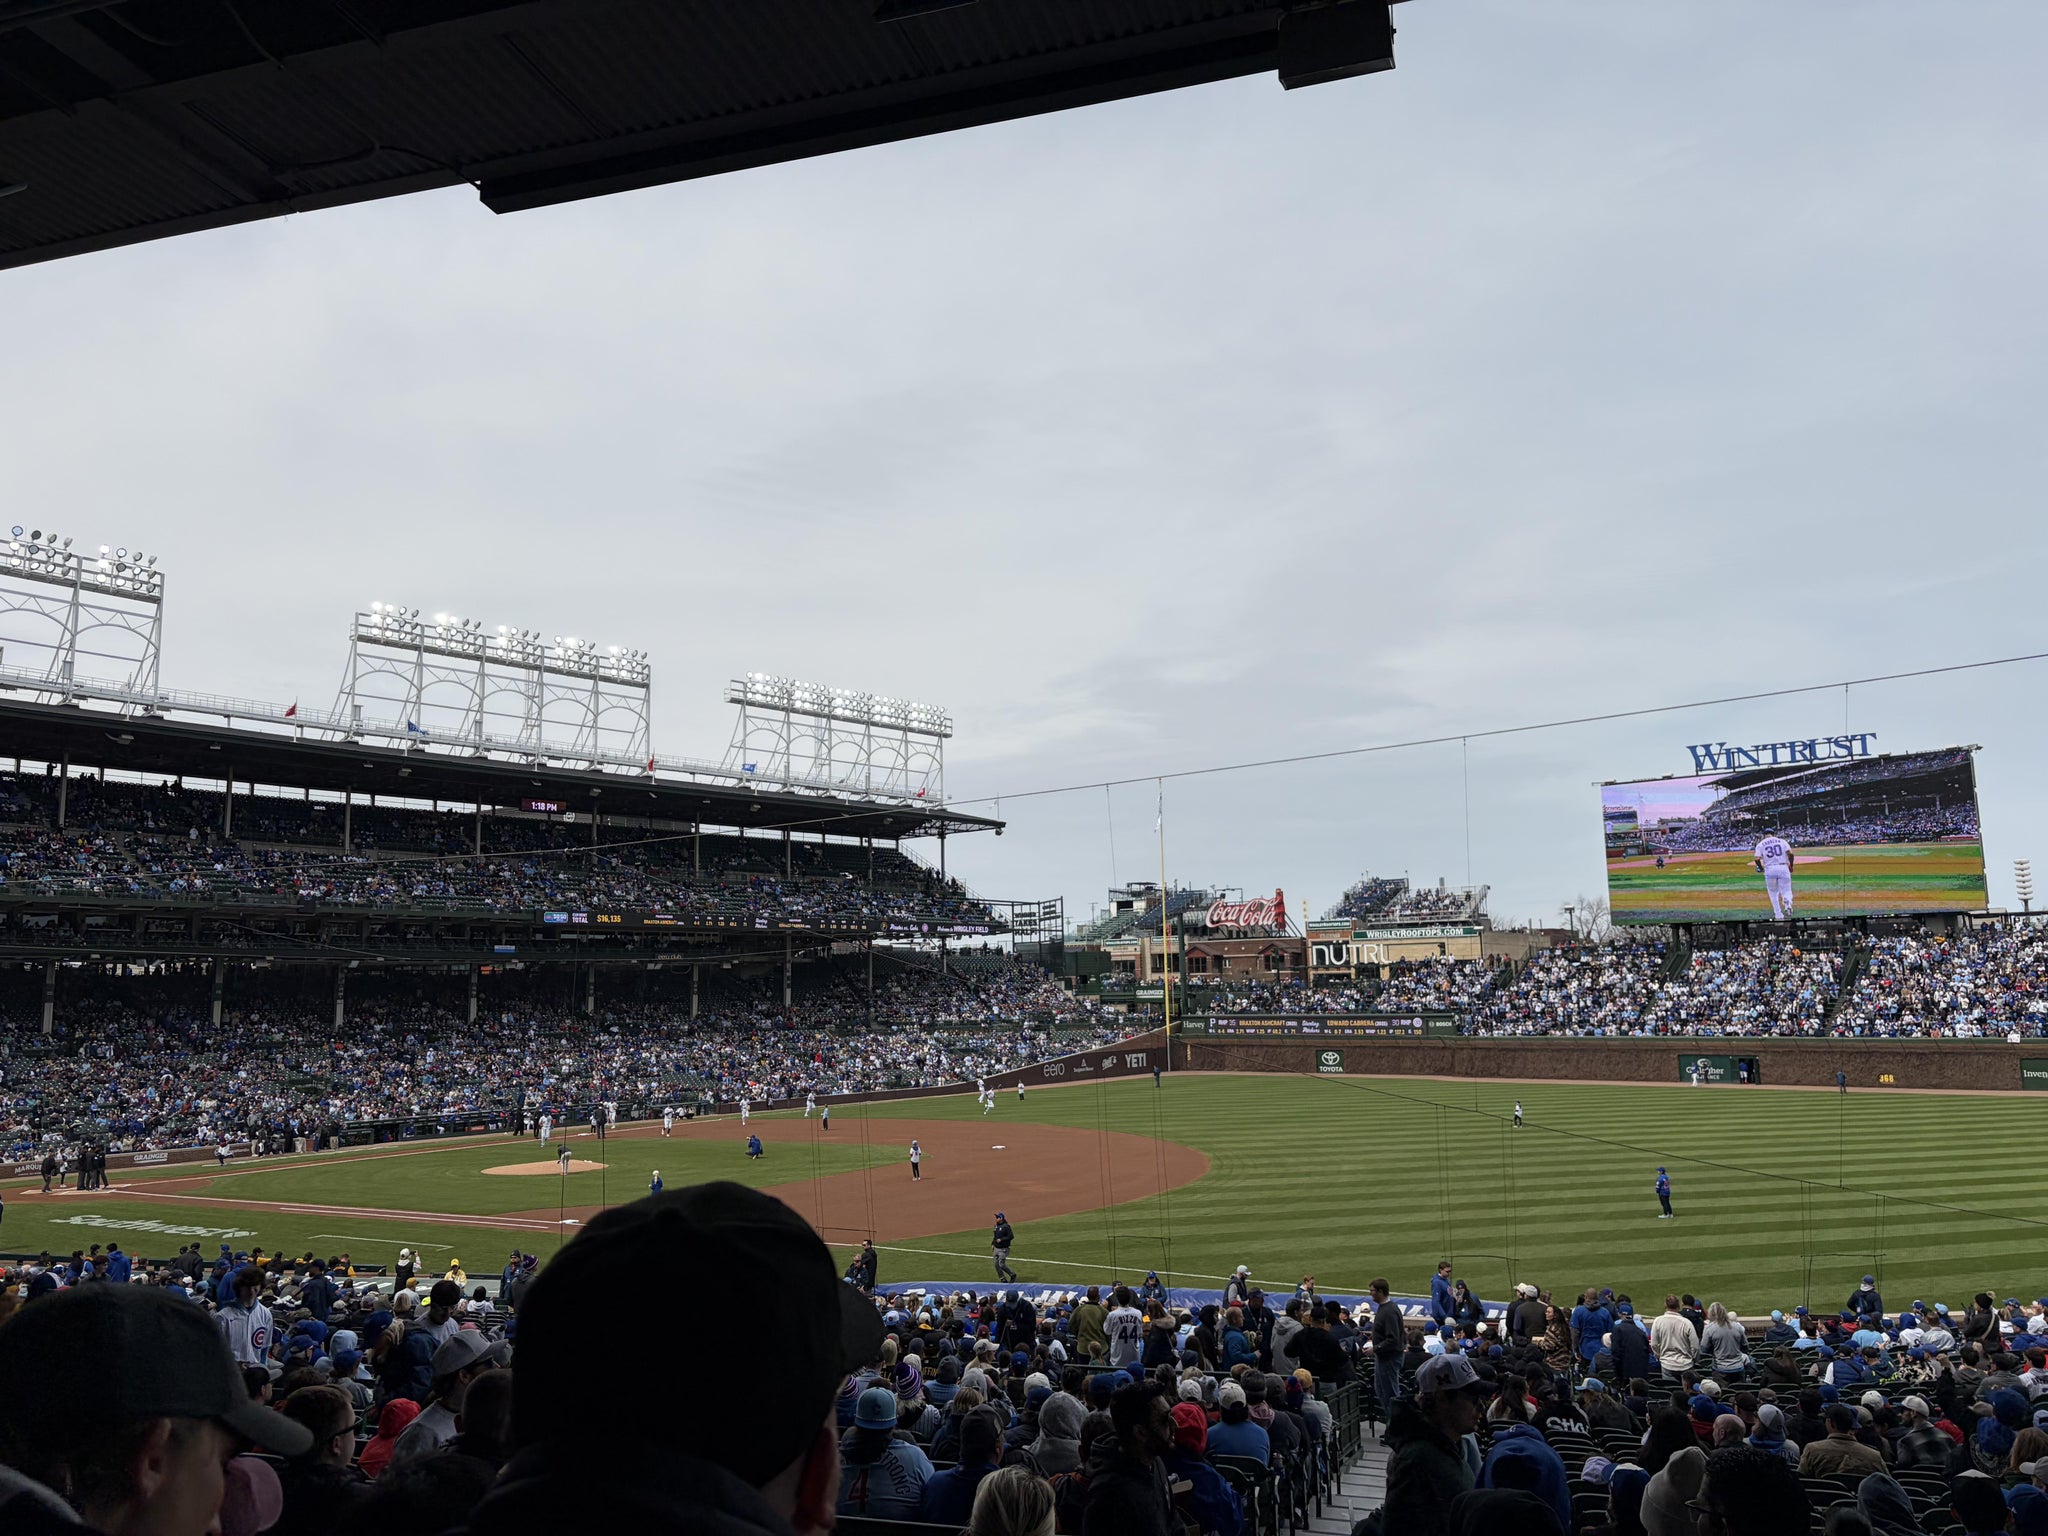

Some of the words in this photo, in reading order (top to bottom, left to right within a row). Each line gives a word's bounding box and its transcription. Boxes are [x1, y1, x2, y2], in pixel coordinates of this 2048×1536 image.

[531, 801, 545, 811] 1:18
[546, 803, 557, 812] PM
[1765, 844, 1783, 858] 30
[596, 914, 622, 923] $16,135
[1205, 898, 1280, 928] Coca-Cola
[571, 916, 589, 924] TOTAL
[1183, 1020, 1205, 1030] Harvey
[1125, 1053, 1147, 1068] YETI
[1043, 1063, 1065, 1077] eero
[1878, 1074, 1894, 1083] 368
[133, 1152, 169, 1161] GRAINGER
[1118, 1325, 1137, 1344] 44
